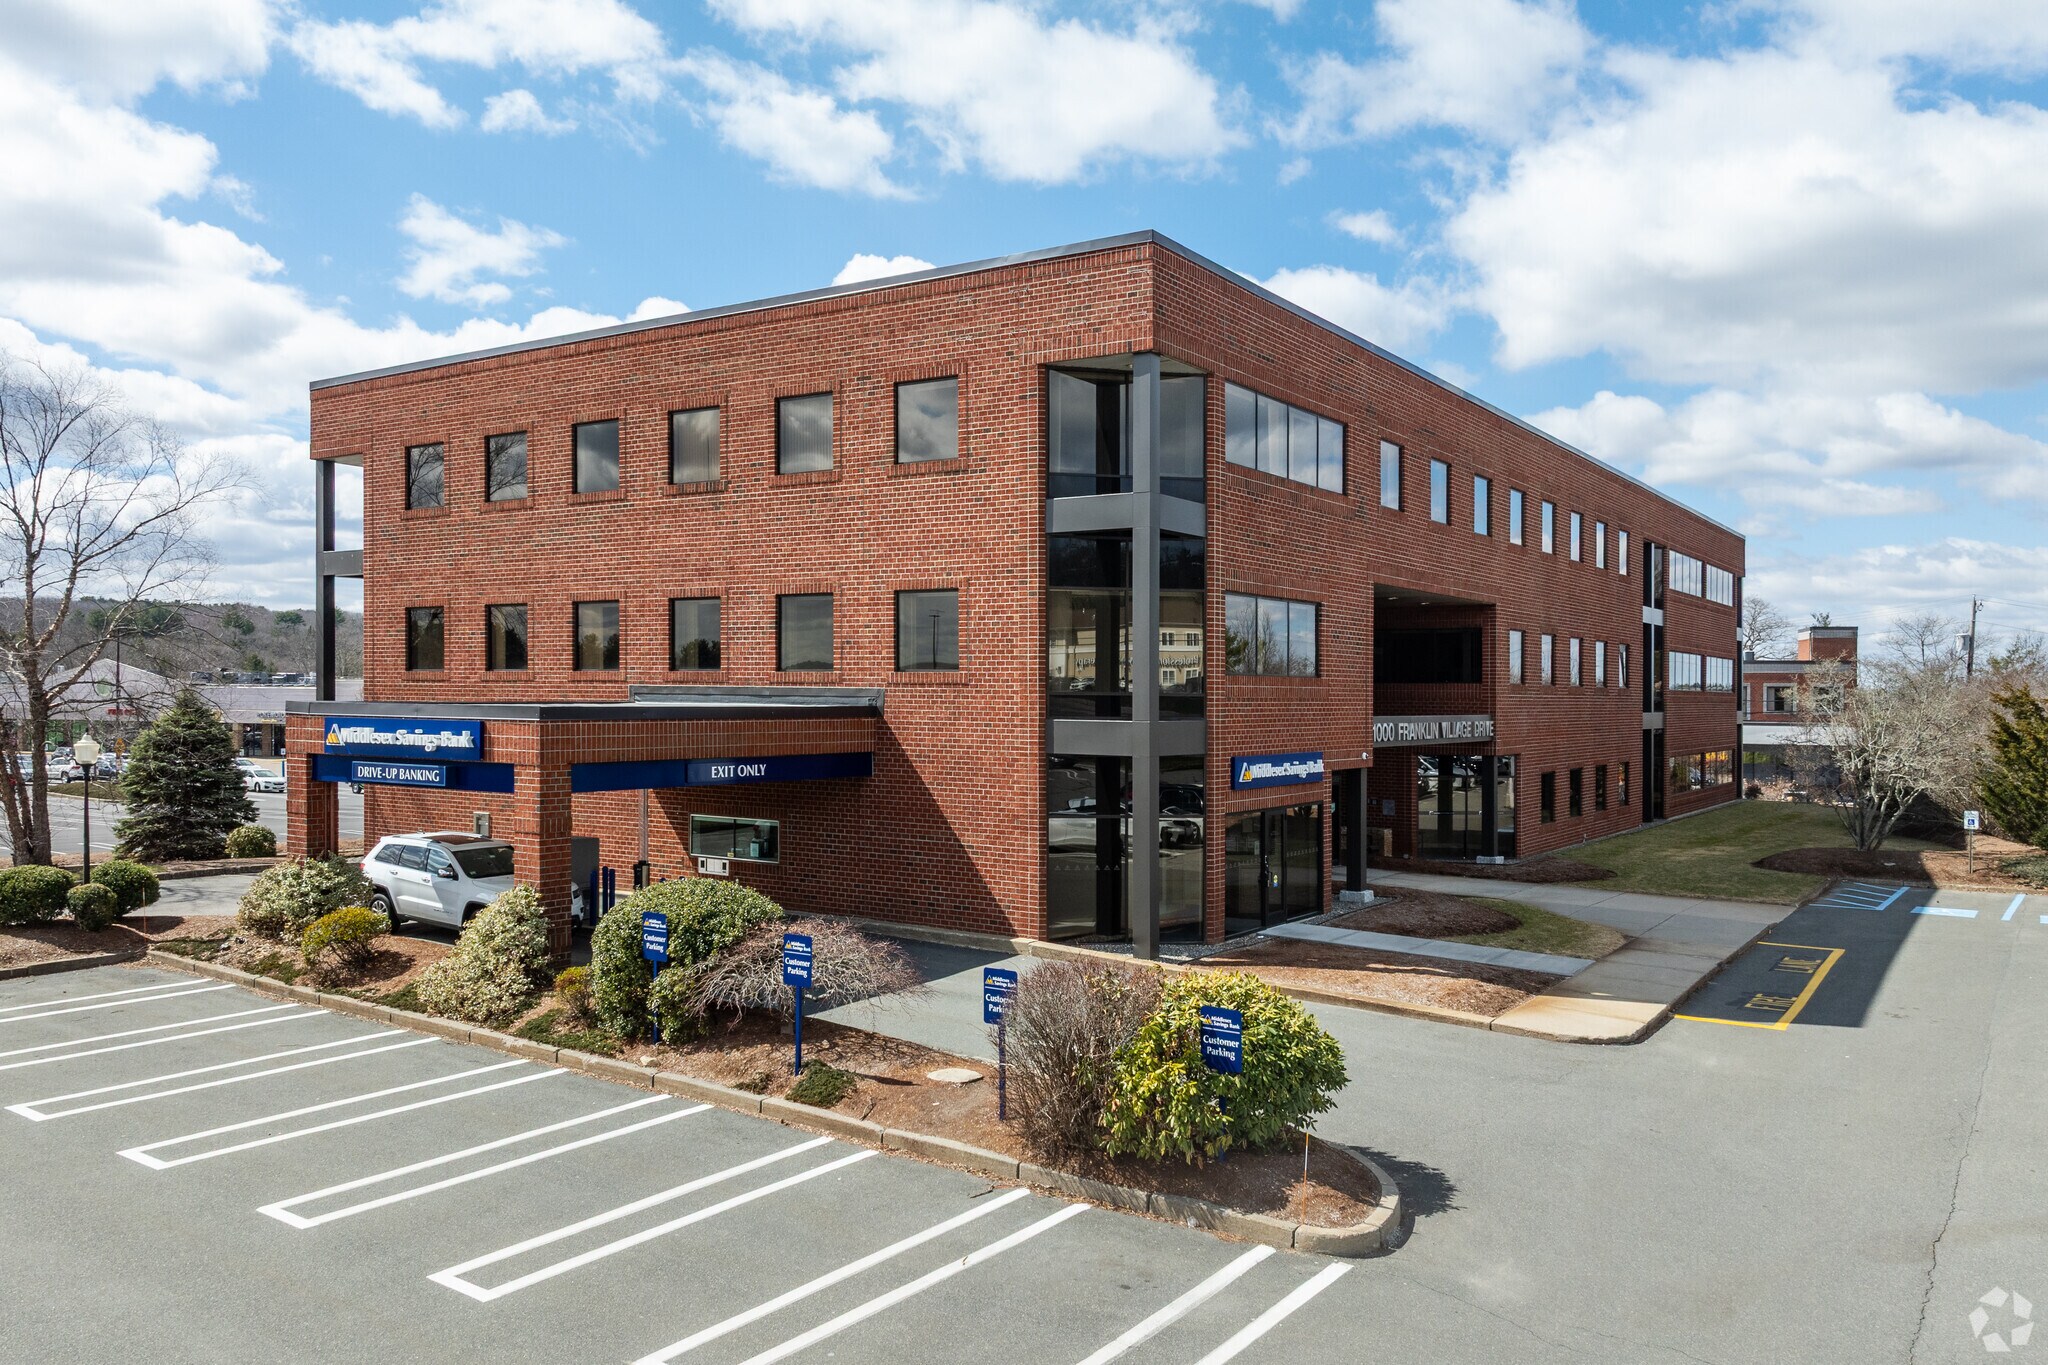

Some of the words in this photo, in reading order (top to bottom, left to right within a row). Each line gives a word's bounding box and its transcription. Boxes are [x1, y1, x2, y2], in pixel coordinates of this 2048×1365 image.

[1373, 722, 1395, 742] 1000
[1398, 721, 1439, 741] FRANKLIN
[1441, 721, 1471, 739] VILLAGE
[1474, 720, 1494, 737] DRIVE
[340, 726, 397, 745] Middlesex
[396, 729, 441, 752] Savings
[440, 731, 474, 748] Bank
[357, 765, 398, 779] DRIVE-UP
[399, 769, 440, 782] BANKING
[711, 765, 736, 778] EXIT
[737, 764, 767, 777] ONLY
[1249, 763, 1284, 779] Middlesex
[1283, 761, 1309, 779] Savings
[1307, 759, 1325, 773] Bank
[643, 933, 667, 943] Customer
[646, 942, 664, 953] Parking
[784, 957, 811, 968] Customer
[787, 966, 808, 979] Parking
[1203, 1035, 1239, 1048] Customer
[1206, 1046, 1236, 1061] Parking
